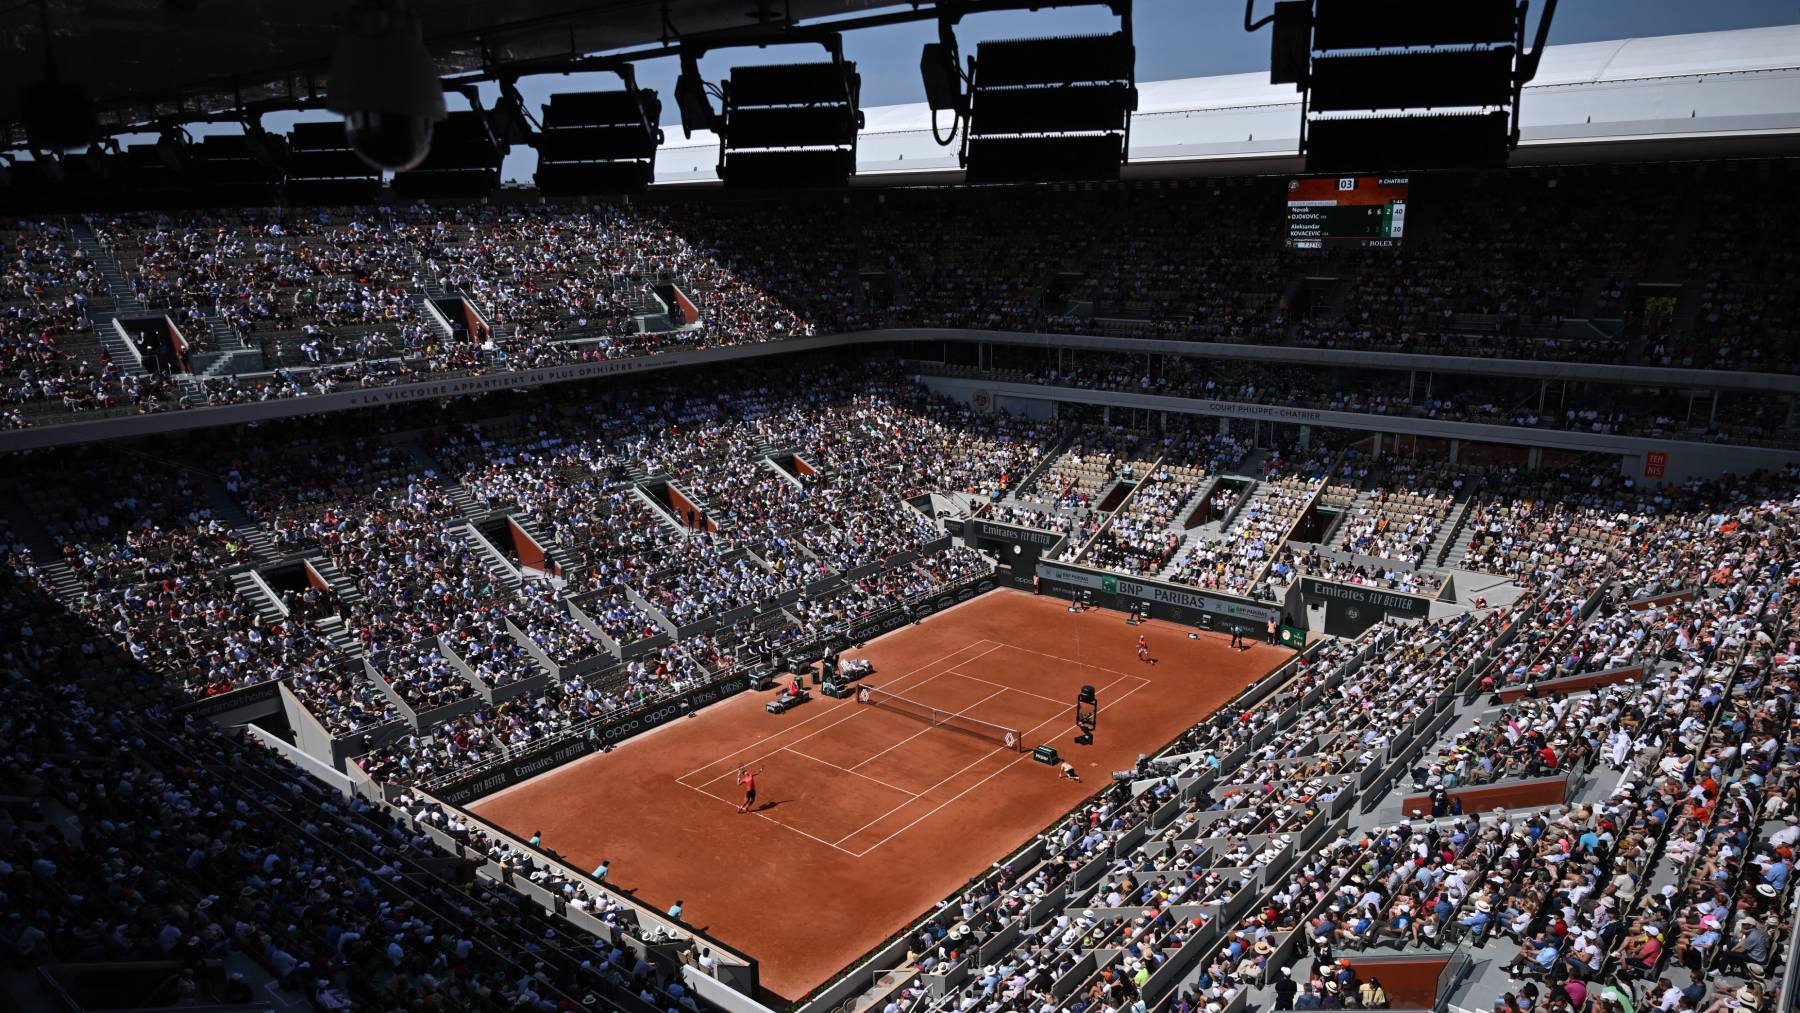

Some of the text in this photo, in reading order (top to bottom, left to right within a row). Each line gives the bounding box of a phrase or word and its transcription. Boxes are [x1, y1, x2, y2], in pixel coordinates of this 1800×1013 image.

[1340, 180, 1353, 189] 03
[363, 394, 379, 404] LA
[385, 386, 447, 400] VICTOIRE
[453, 376, 526, 392] APPARTIENT
[530, 374, 544, 383] AU
[550, 370, 574, 381] PLUS
[579, 362, 633, 376] OPINIÂTRE
[1209, 402, 1237, 413] COURT
[1238, 405, 1273, 416] PHILIPPE
[1280, 409, 1321, 420] CHATRIER
[1650, 455, 1664, 464] TEN
[1647, 466, 1661, 475] NIS
[983, 524, 1051, 545] Emirates FLY BETTER
[1015, 576, 1034, 585] oppo
[1119, 582, 1205, 609] BNP PARIBAS
[1314, 582, 1413, 610] Emirates FLY BETTER
[882, 614, 905, 629] oppo
[857, 624, 880, 640] oppo
[644, 704, 676, 724] oppo
[606, 720, 638, 739] oppo
[514, 741, 585, 777] Emirates FLY BETTER
[472, 783, 483, 794] FLY
[484, 773, 506, 789] BETTER
